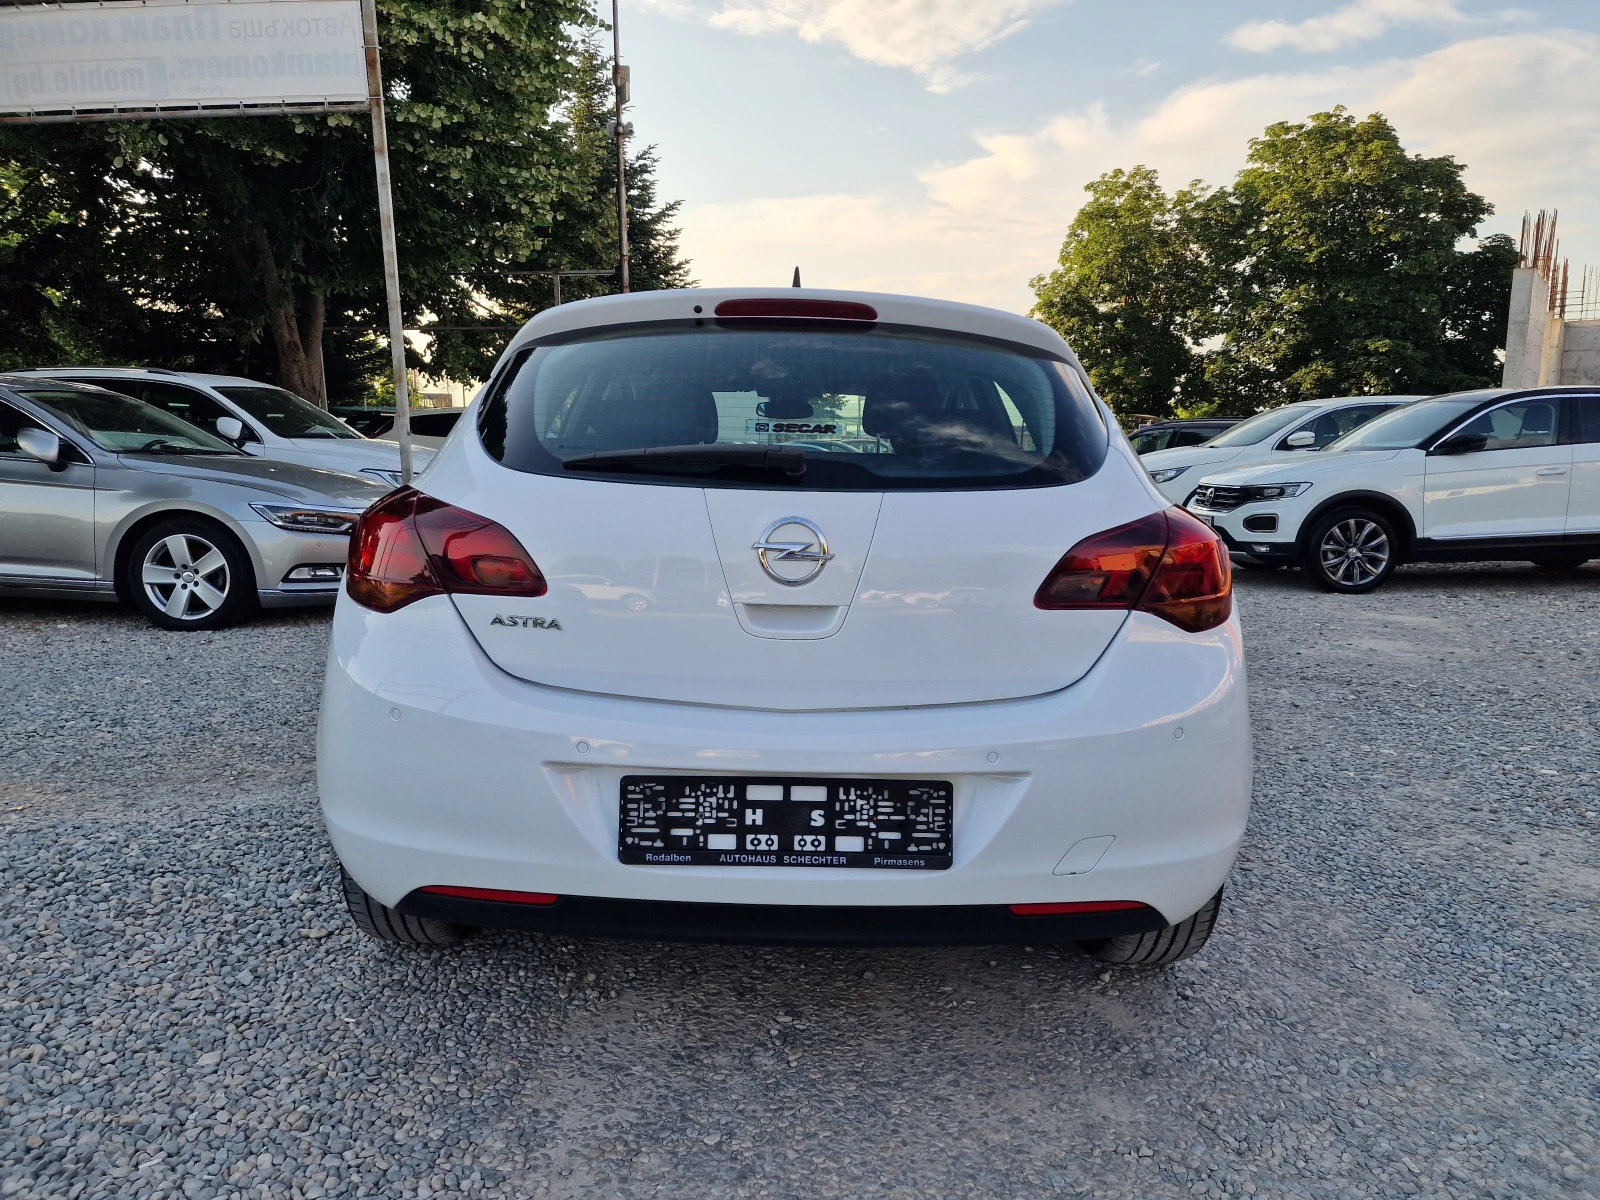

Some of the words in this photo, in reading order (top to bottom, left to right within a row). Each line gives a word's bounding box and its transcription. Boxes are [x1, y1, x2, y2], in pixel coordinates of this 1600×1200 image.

[771, 422, 837, 435] SECAR
[489, 613, 564, 631] ASTRA
[645, 853, 693, 863] Rodalben
[719, 854, 777, 864] AUTOHAUS
[783, 855, 848, 865] SCHECHTER
[873, 857, 926, 867] Pirmasens
